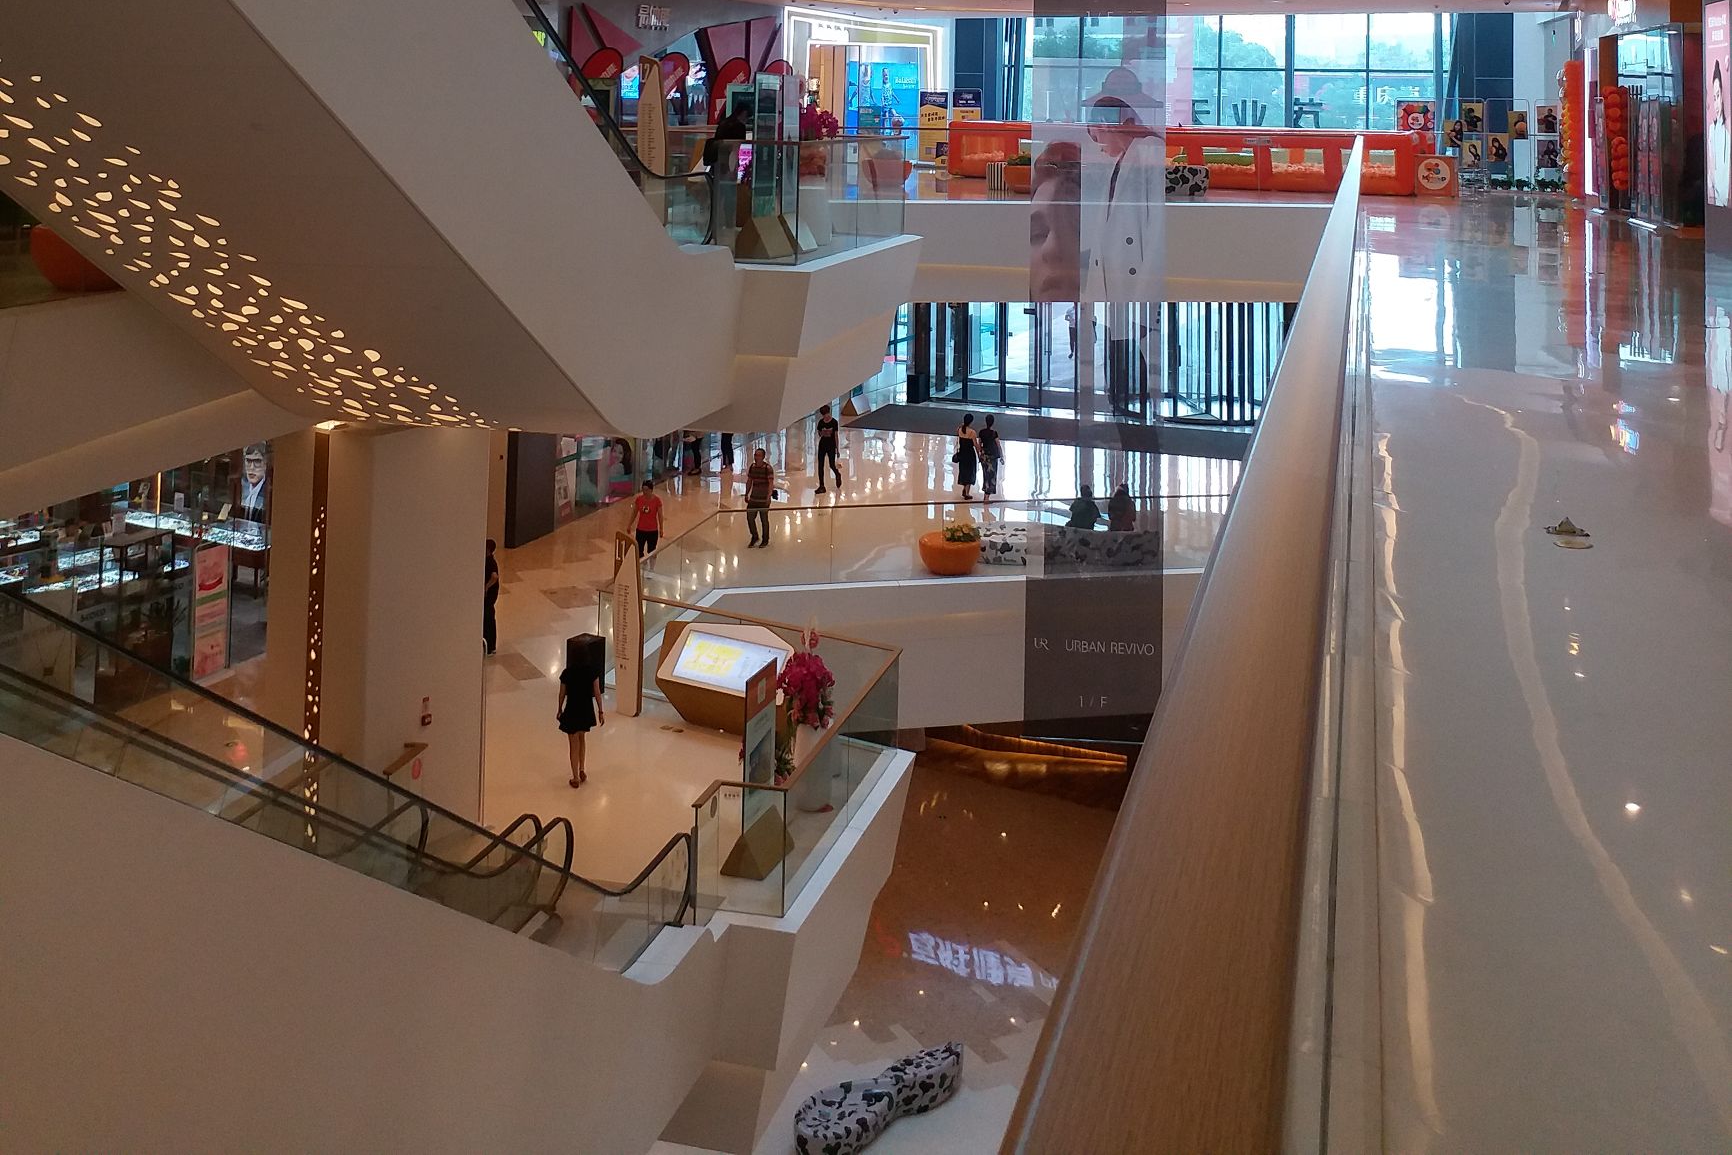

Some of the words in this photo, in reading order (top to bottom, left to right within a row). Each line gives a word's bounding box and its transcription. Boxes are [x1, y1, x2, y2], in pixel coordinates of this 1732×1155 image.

[1033, 637, 1050, 651] UR
[1065, 639, 1106, 653] URBAN
[1110, 642, 1155, 656] REVIVO
